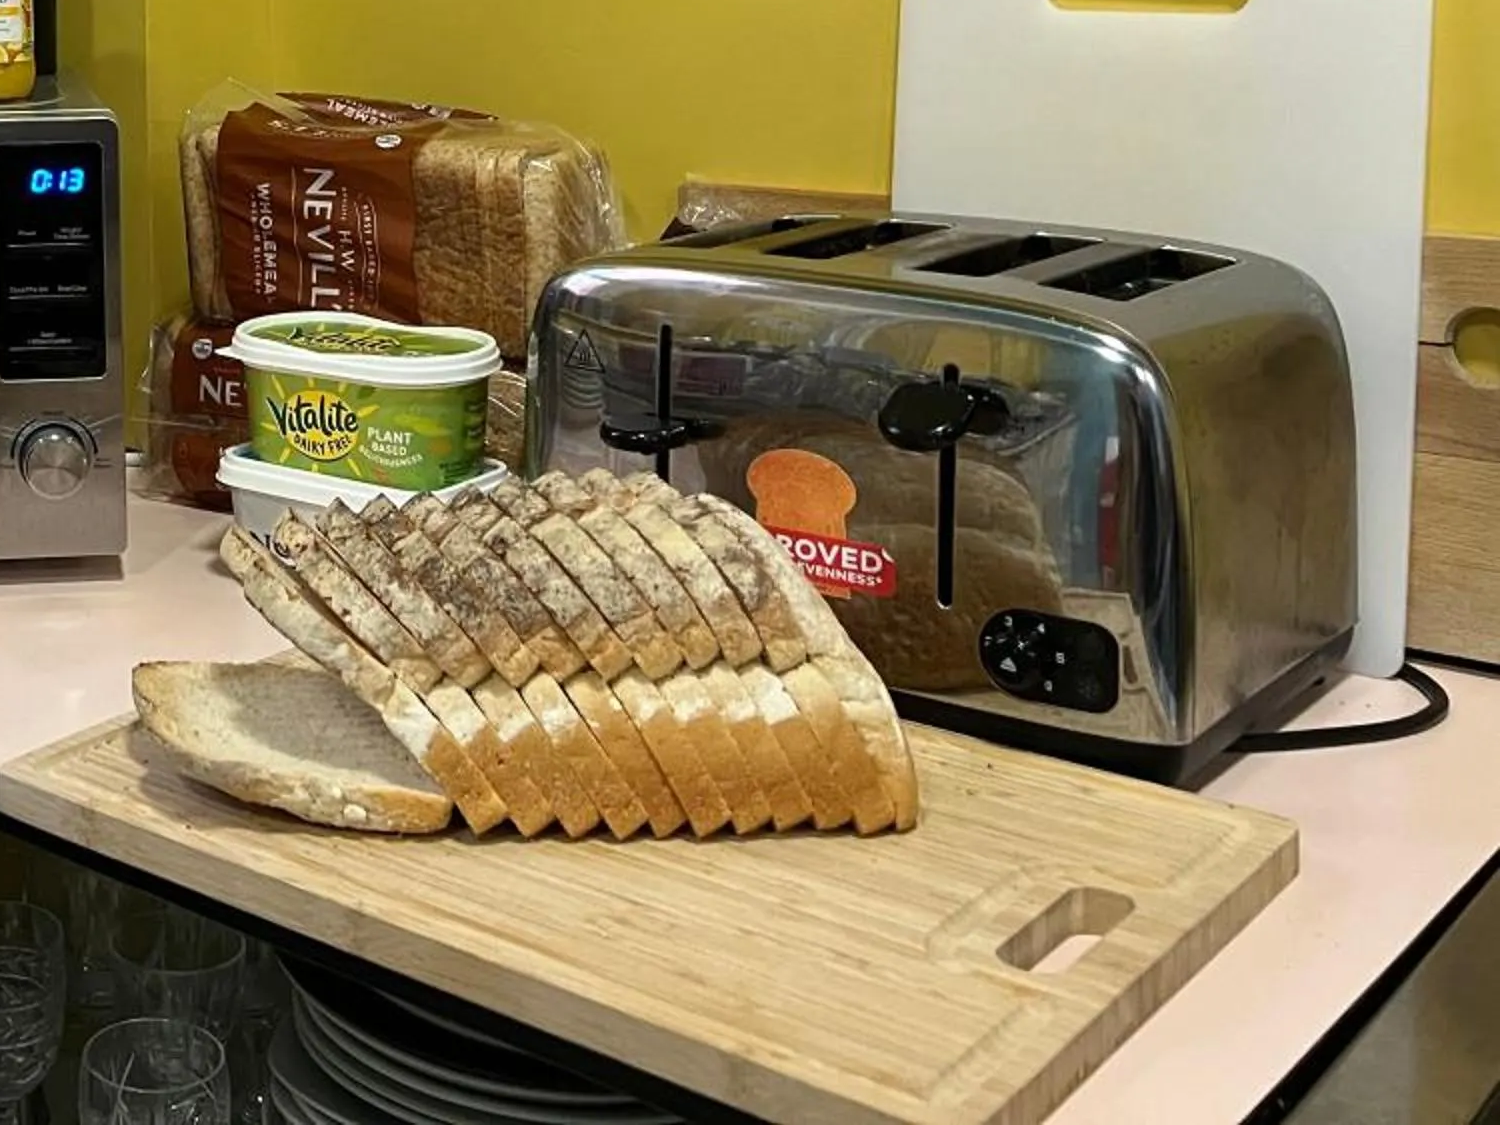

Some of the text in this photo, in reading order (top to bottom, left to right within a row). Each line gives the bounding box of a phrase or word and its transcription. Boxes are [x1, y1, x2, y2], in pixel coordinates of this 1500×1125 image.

[30, 168, 85, 193] 0:13
[303, 167, 342, 311] NEVILL'
[199, 374, 248, 407] NE
[266, 394, 359, 437] Vitalite
[293, 434, 352, 455] DAIRY FREE
[367, 426, 414, 446] PLANT
[376, 440, 408, 456] BASED
[776, 534, 883, 573] ROVED
